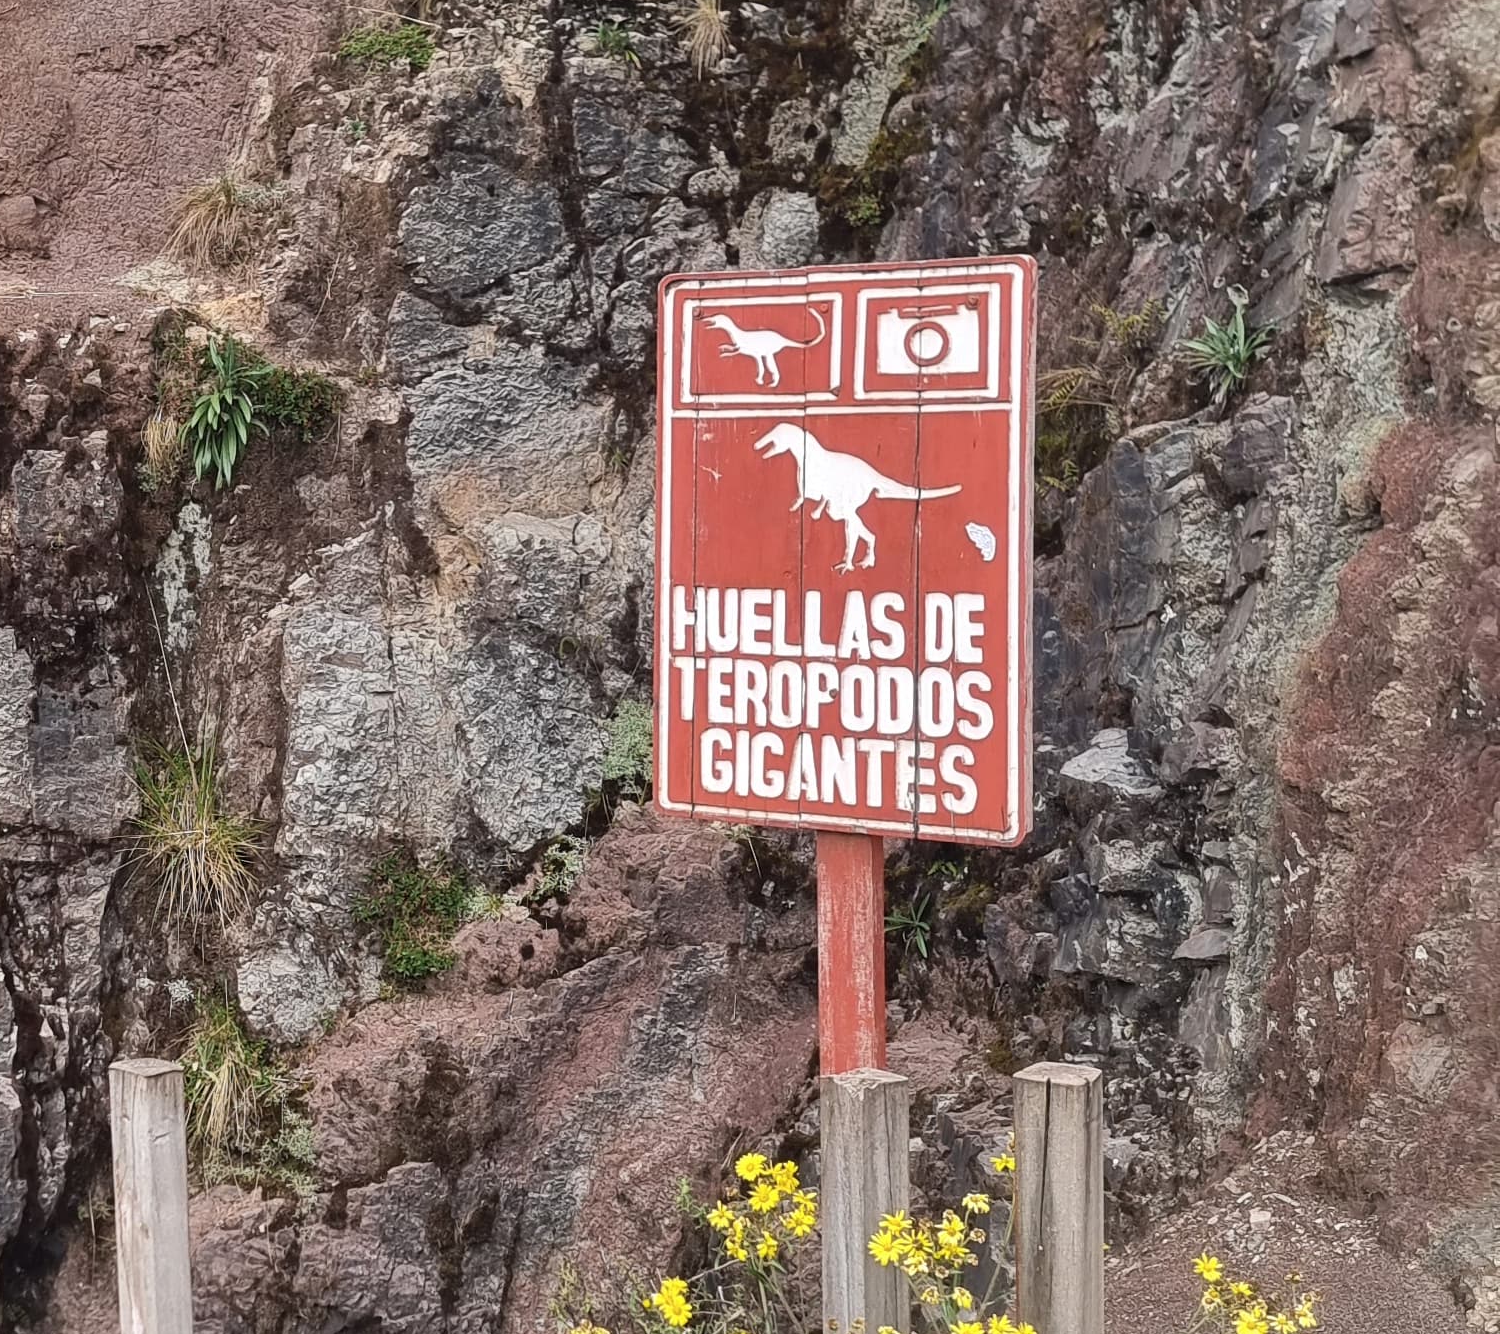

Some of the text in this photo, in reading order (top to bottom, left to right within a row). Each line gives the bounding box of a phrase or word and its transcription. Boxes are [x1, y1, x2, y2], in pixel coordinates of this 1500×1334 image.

[673, 584, 986, 663] HUELLAS DE
[672, 655, 994, 740] TEROPODOS
[700, 727, 978, 814] GIGANTES
